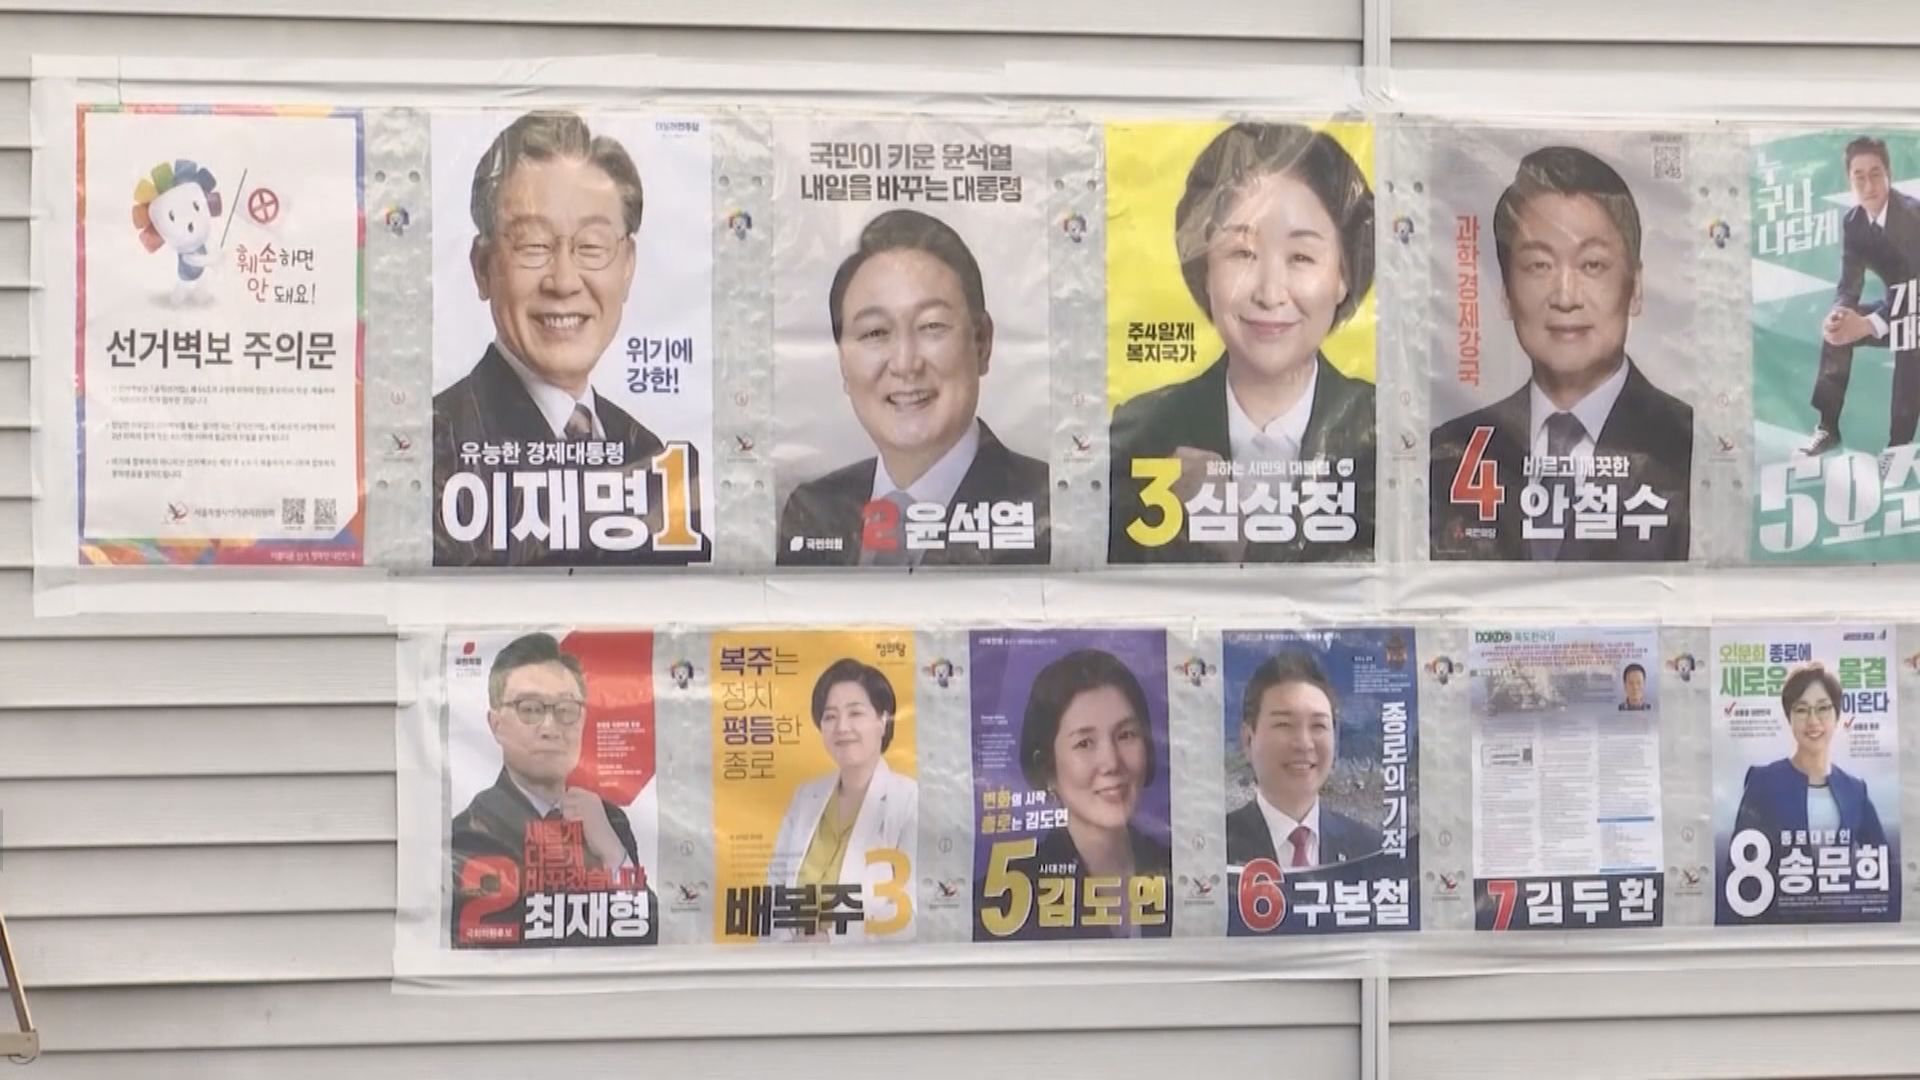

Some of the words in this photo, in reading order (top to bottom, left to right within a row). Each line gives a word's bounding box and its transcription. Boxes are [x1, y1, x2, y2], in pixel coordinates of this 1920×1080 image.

[809, 141, 881, 170] 국민이
[888, 143, 936, 170] 키운
[942, 144, 1013, 171] 윤석열
[801, 173, 872, 201] 내일을
[877, 176, 949, 202] 바꾸는
[953, 176, 1023, 203] 대통령
[1758, 208, 1839, 256] 나답게
[236, 242, 315, 273] 훼손하면
[247, 277, 269, 303] 안
[274, 283, 316, 305] 돼요!
[1127, 322, 1195, 342] 주4일제
[106, 328, 233, 369] 선거벽보
[243, 330, 337, 371] 주의문
[626, 337, 693, 364] 위기에
[1126, 343, 1197, 364] 복지국가
[627, 367, 680, 394] 강한!
[459, 441, 520, 466] 유능한
[526, 441, 625, 466] 경제대통령
[1522, 455, 1575, 478] 바르고
[1577, 455, 1631, 478] 깨끗한
[1450, 425, 1505, 522] 4
[441, 468, 649, 551] 이재명
[651, 441, 703, 551] 1
[1125, 458, 1183, 547] 3
[1183, 482, 1358, 542] 심상정
[1519, 483, 1669, 540] 안철수
[1758, 455, 1822, 553] 5
[861, 497, 899, 553] 2
[905, 502, 1035, 550] 윤석열
[720, 646, 799, 677] 복주는
[1769, 642, 1812, 664] 종로에
[1719, 665, 1789, 698] 새로운
[1838, 656, 1888, 690] 물결
[721, 680, 773, 712] 정치
[722, 714, 803, 746] 평등한
[722, 750, 776, 781] 종로
[1025, 790, 1047, 806] 시작
[1025, 807, 1069, 831] 김도연
[980, 837, 1038, 938] 5
[1037, 874, 1168, 928] 김도연
[1725, 828, 1776, 918] 8
[1778, 844, 1890, 895] 송문희
[460, 855, 521, 928] 2
[524, 890, 650, 940] 최재형
[725, 883, 865, 937] 배복주
[863, 847, 915, 937] 3
[1238, 857, 1288, 933] 6
[1292, 877, 1410, 928] 구본철
[1487, 879, 1518, 934] 7
[1525, 877, 1657, 926] 김두환
